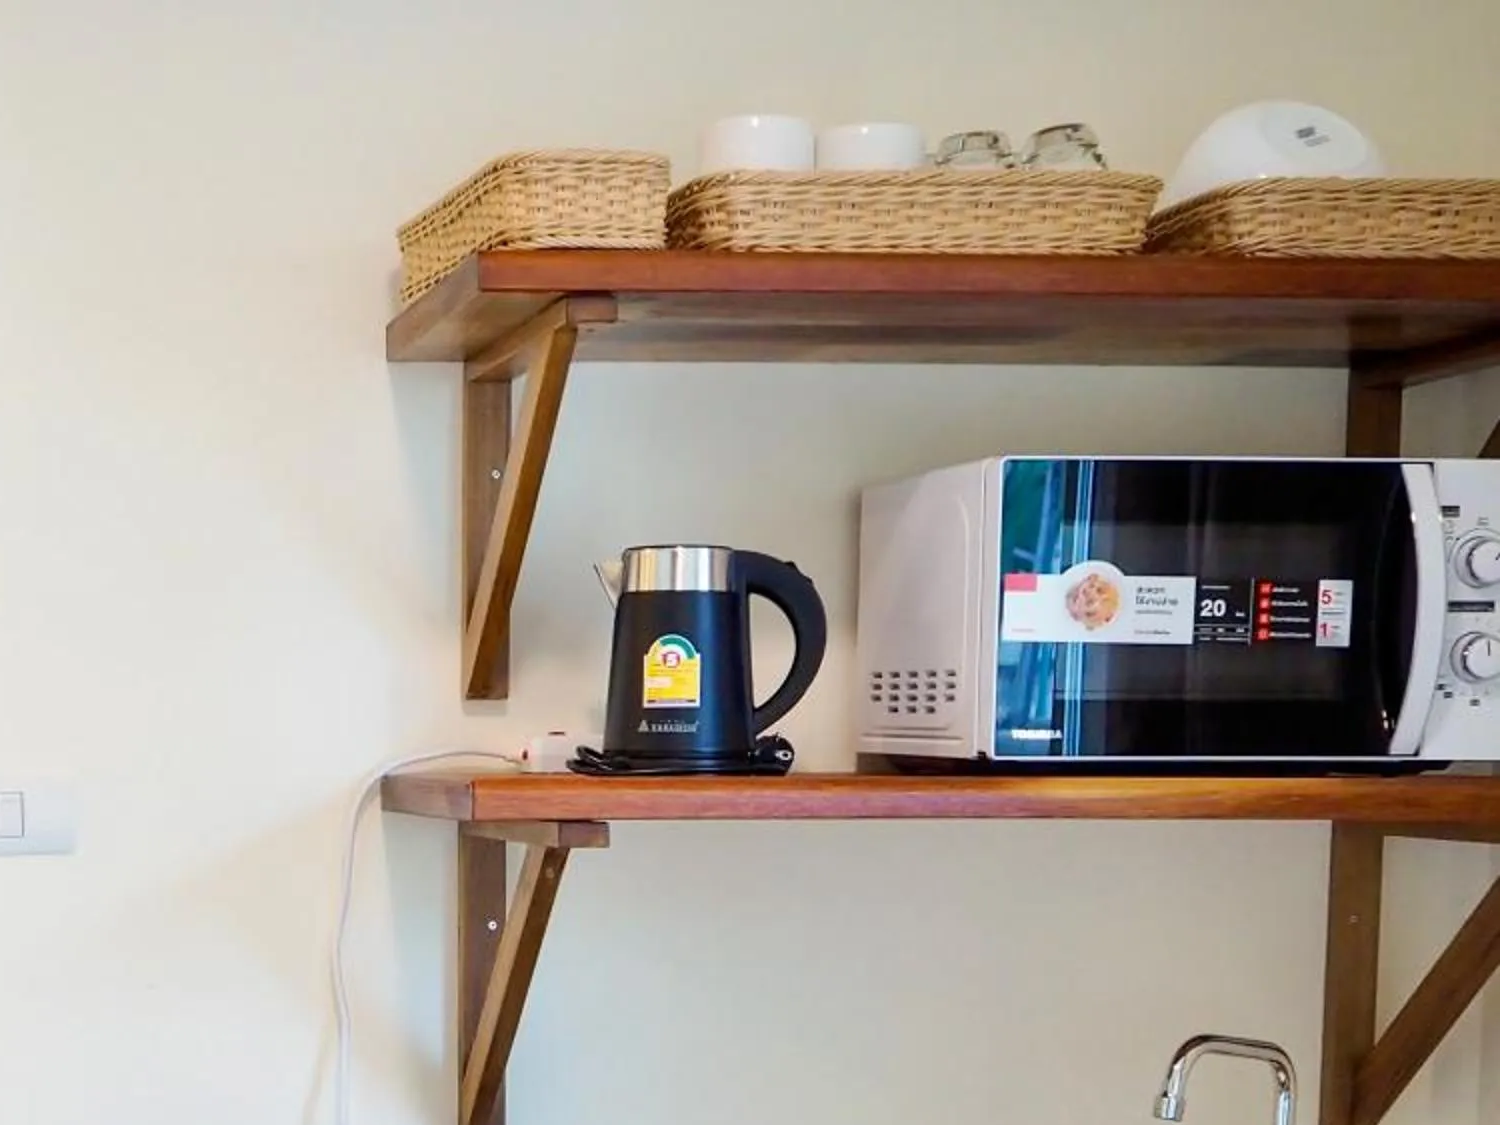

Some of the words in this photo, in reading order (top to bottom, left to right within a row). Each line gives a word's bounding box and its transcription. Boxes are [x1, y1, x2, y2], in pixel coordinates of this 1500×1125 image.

[1321, 589, 1333, 605] 5
[1200, 598, 1227, 617] 20
[1320, 622, 1329, 638] 1
